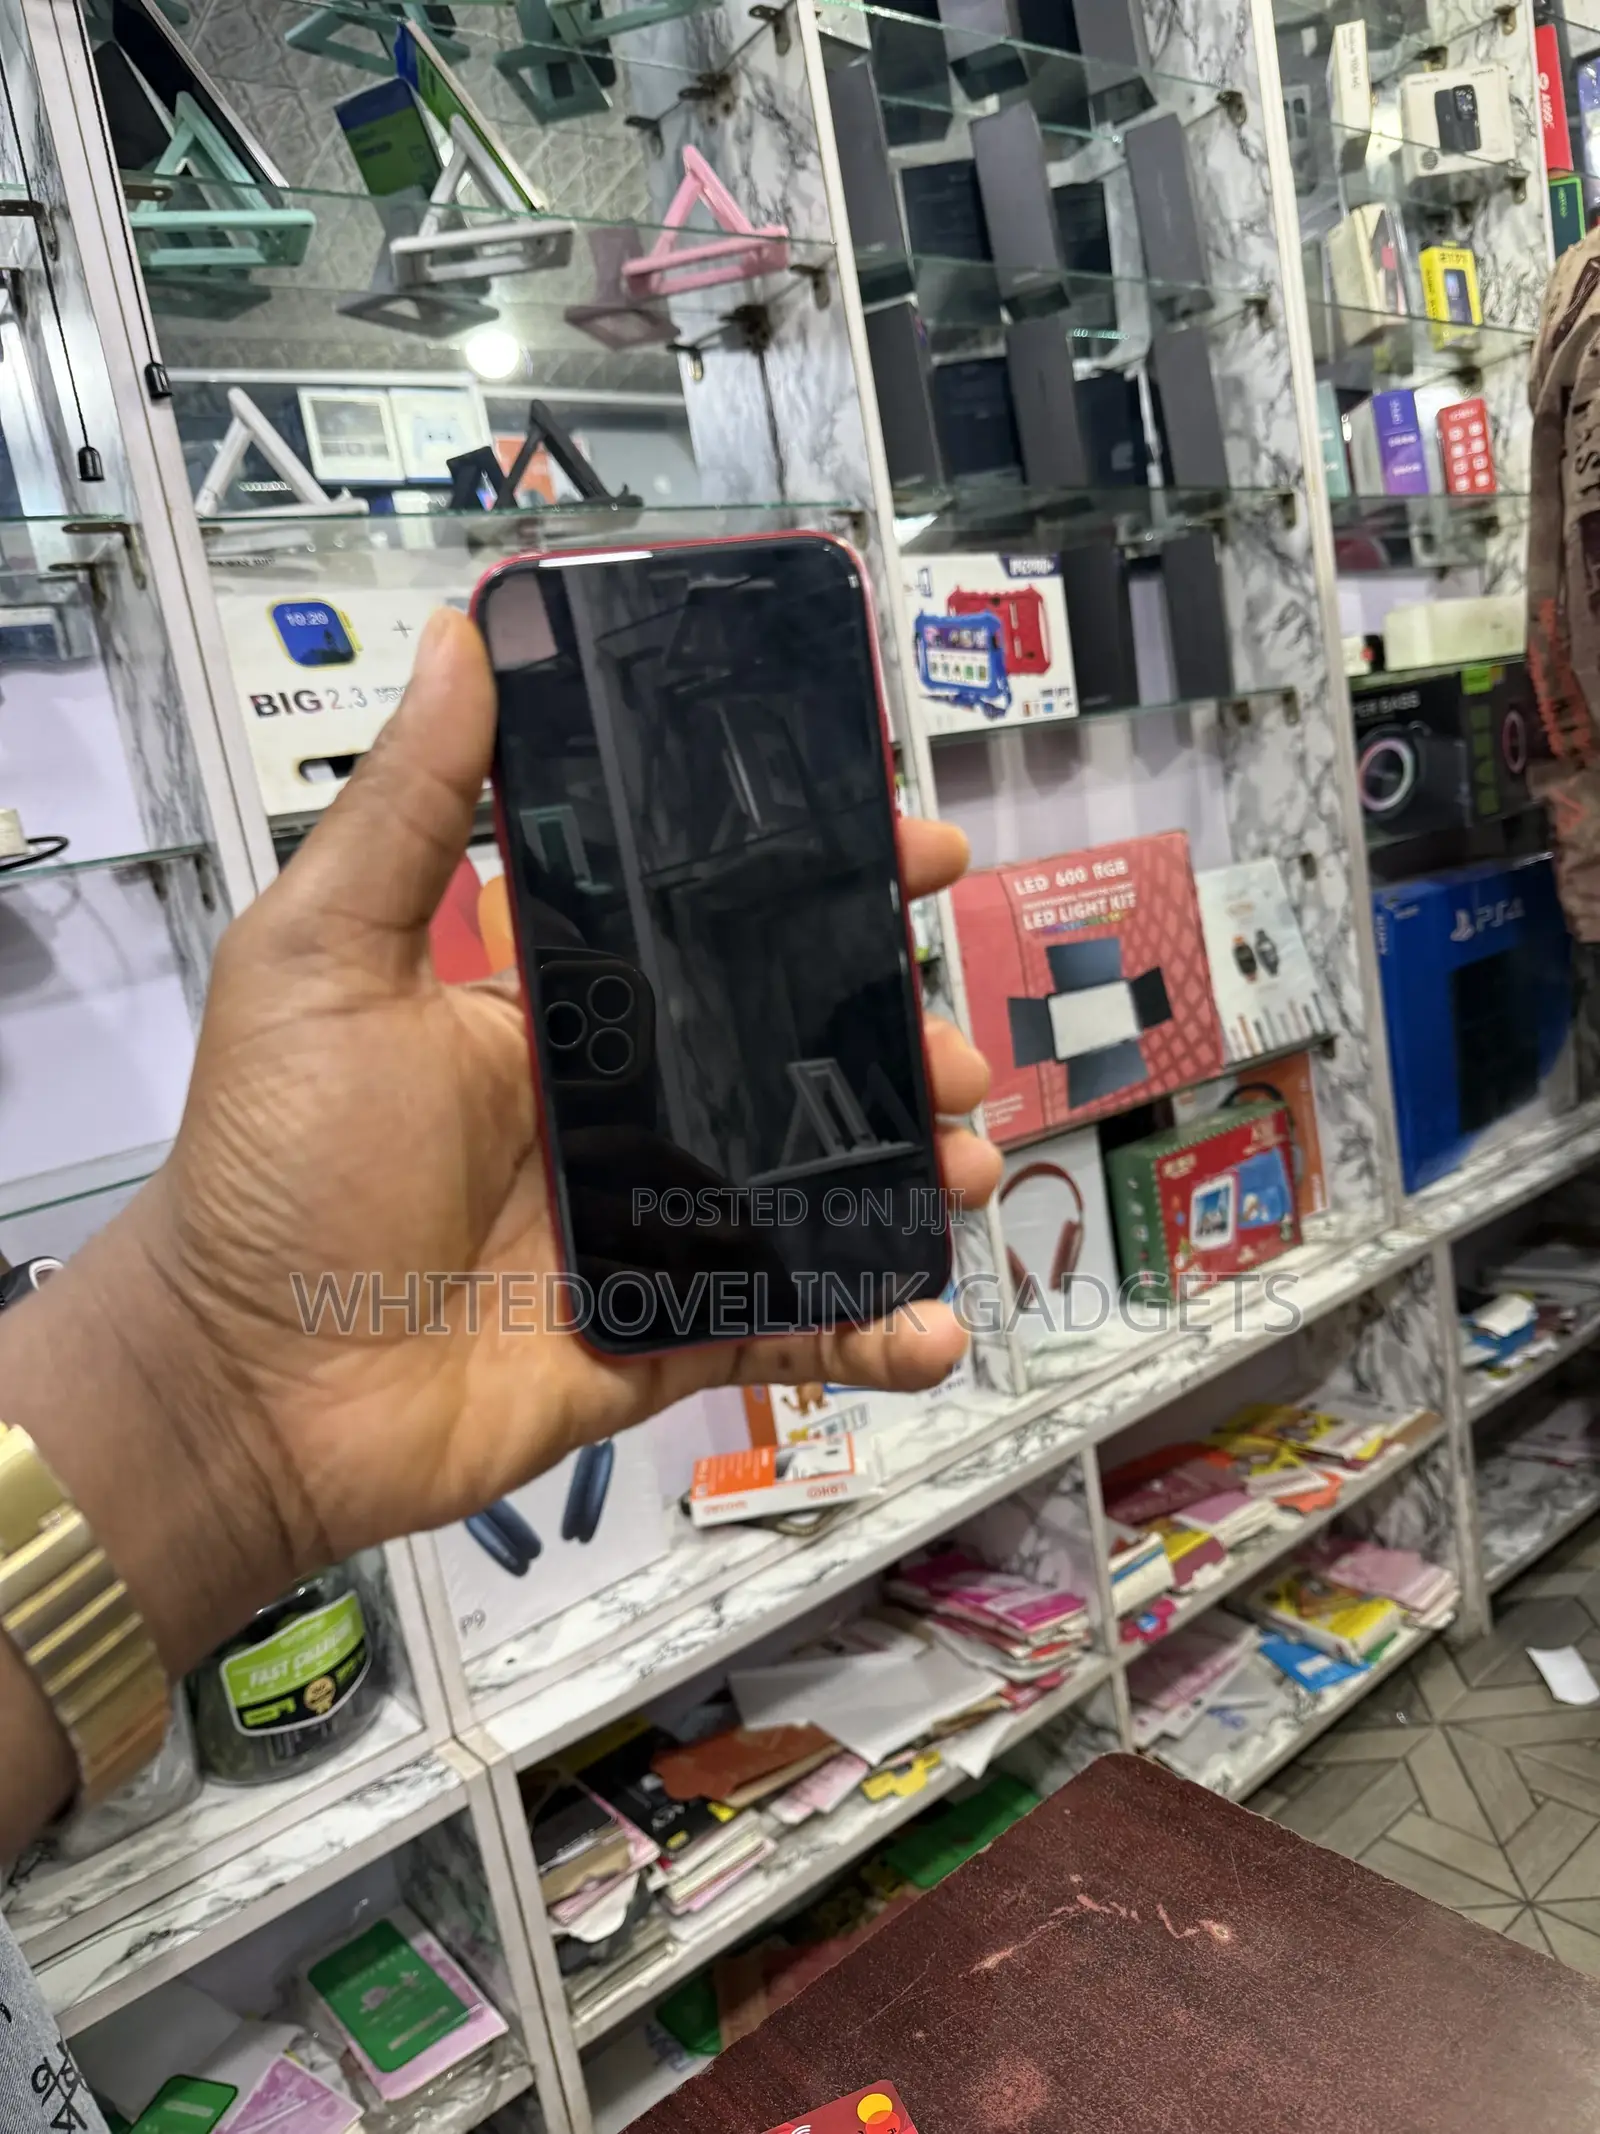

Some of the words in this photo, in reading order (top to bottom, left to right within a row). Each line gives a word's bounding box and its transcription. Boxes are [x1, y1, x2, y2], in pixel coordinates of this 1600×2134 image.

[250, 690, 323, 718] BIG
[326, 687, 369, 710] 2.3
[1379, 690, 1421, 714] BASS
[1014, 873, 1050, 896] LED
[1055, 864, 1089, 887] 600
[1091, 856, 1129, 880] RGB
[1022, 908, 1056, 931] LED
[1058, 897, 1108, 923] LIGHT
[1109, 890, 1137, 912] KIT
[1475, 898, 1526, 933] PS4
[459, 1608, 487, 1640] P9
[250, 1659, 289, 1689] FAST
